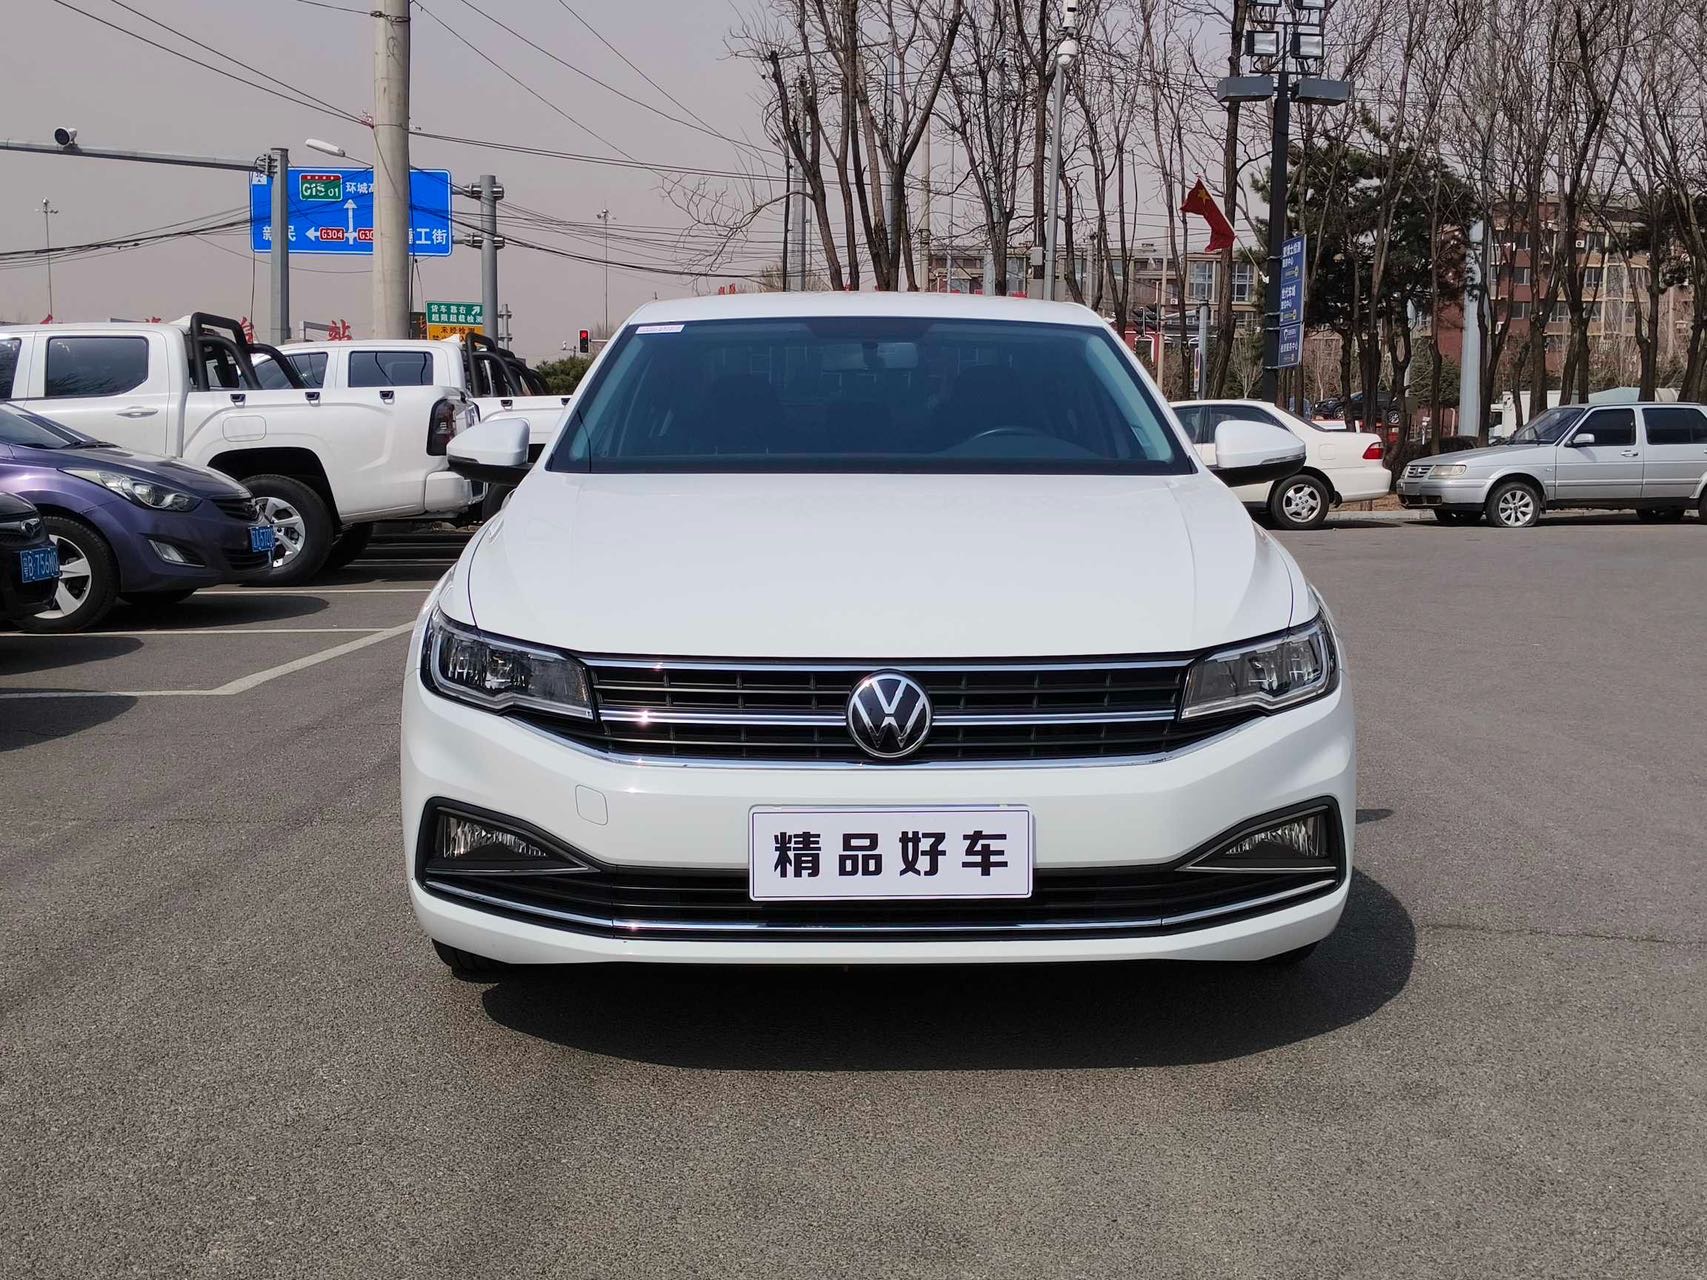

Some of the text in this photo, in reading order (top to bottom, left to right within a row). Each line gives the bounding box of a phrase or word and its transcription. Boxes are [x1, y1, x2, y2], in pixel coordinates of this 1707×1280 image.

[321, 229, 343, 239] G304
[359, 230, 374, 240] G30
[774, 830, 1009, 878] 精品好车
